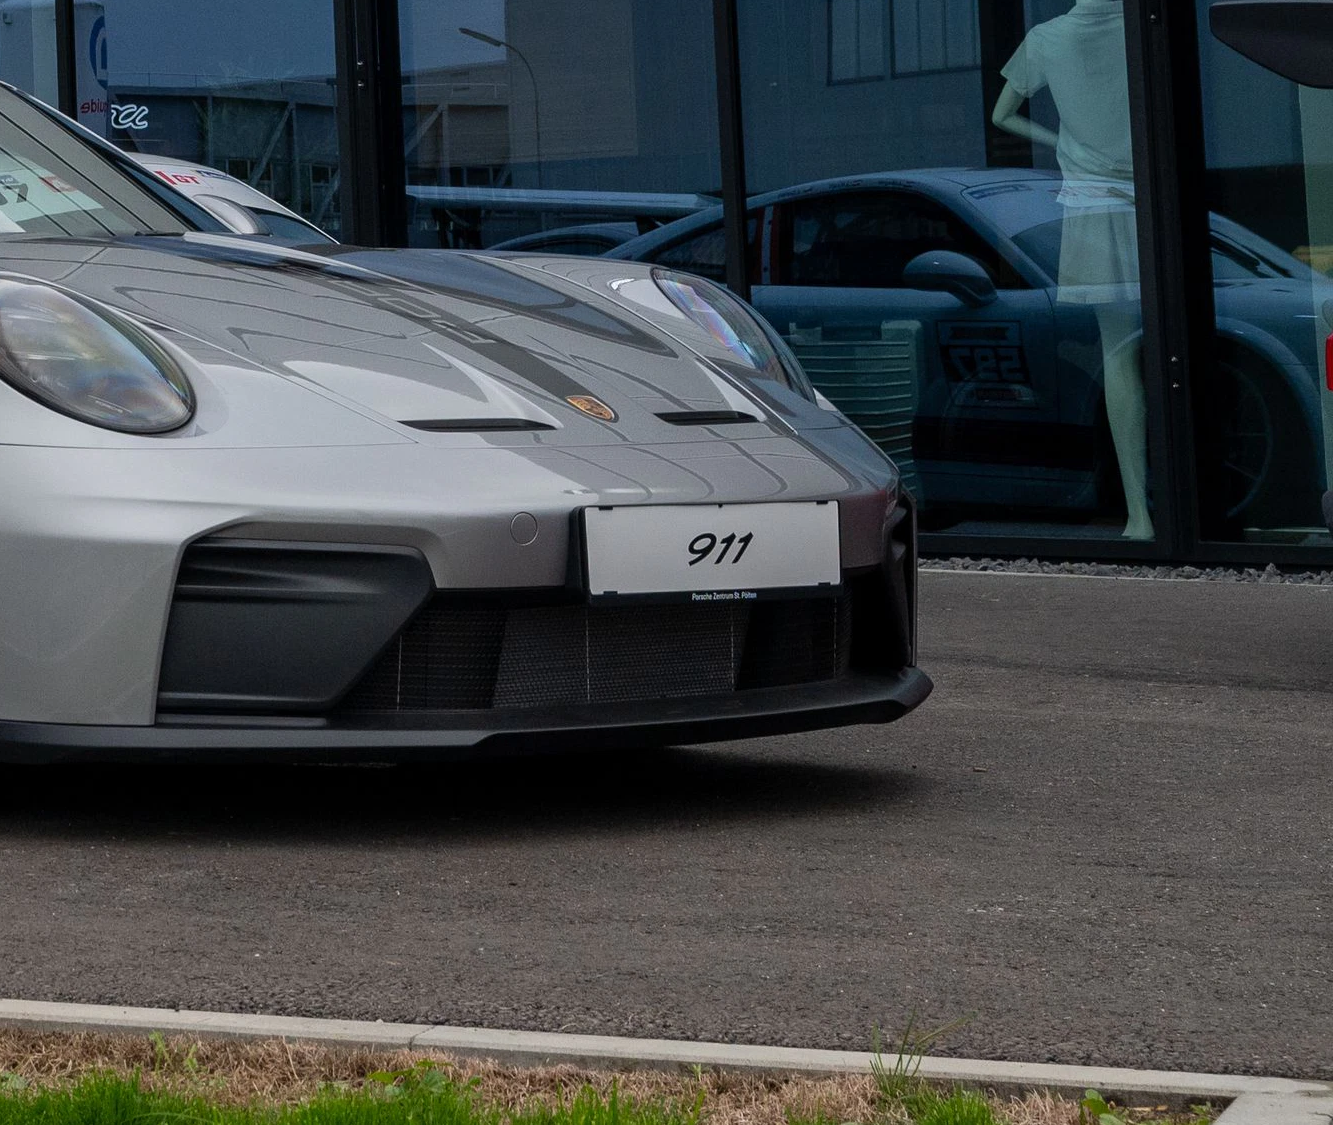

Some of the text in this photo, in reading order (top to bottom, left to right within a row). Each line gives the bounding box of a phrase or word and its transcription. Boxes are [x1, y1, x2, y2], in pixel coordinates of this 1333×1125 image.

[688, 531, 754, 567] 911
[691, 592, 713, 601] Porsche
[713, 591, 734, 600] Zentrum
